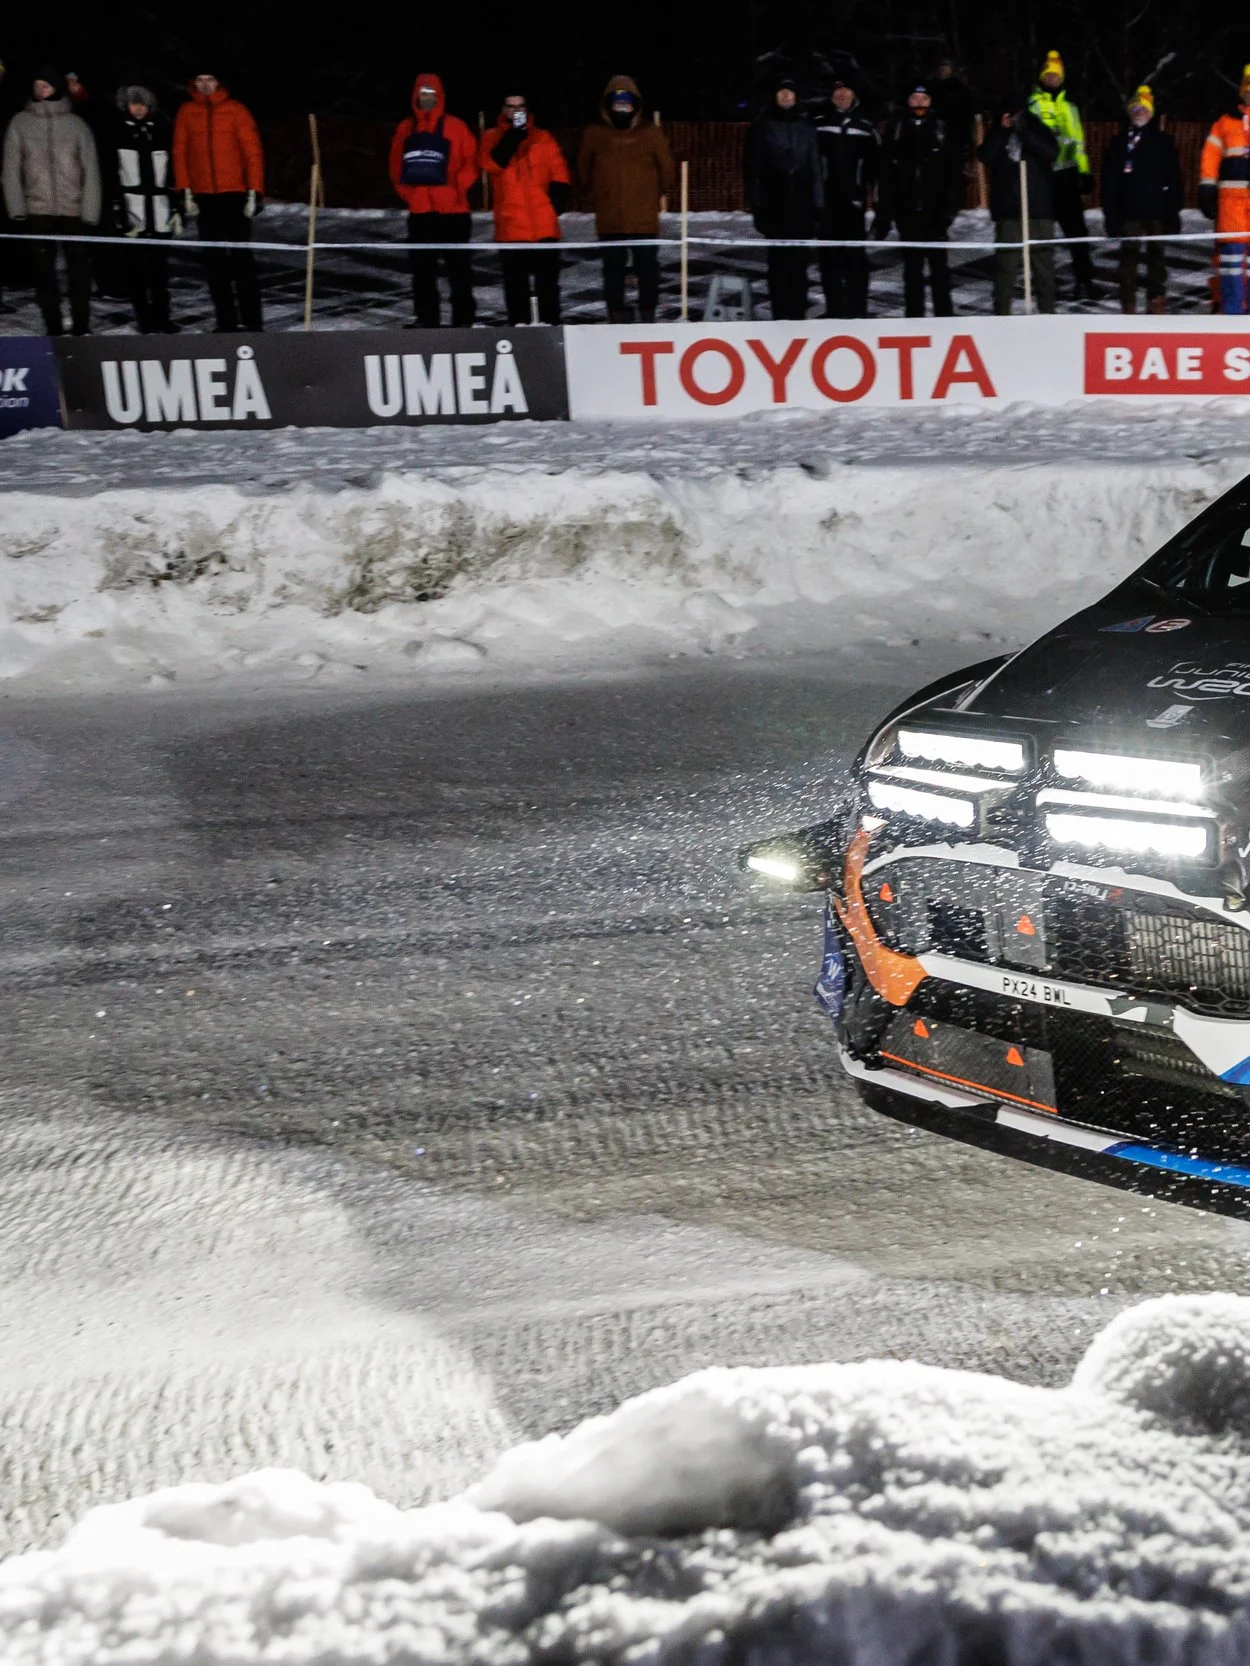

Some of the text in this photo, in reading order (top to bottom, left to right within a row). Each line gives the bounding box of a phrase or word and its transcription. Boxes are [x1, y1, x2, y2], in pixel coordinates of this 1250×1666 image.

[0, 367, 30, 391] K
[101, 345, 272, 424] UMEÅ
[364, 340, 529, 417] UMEÅ
[619, 335, 997, 406] TOYOTA
[1104, 347, 1204, 380] BAE
[1003, 977, 1037, 999] PX24
